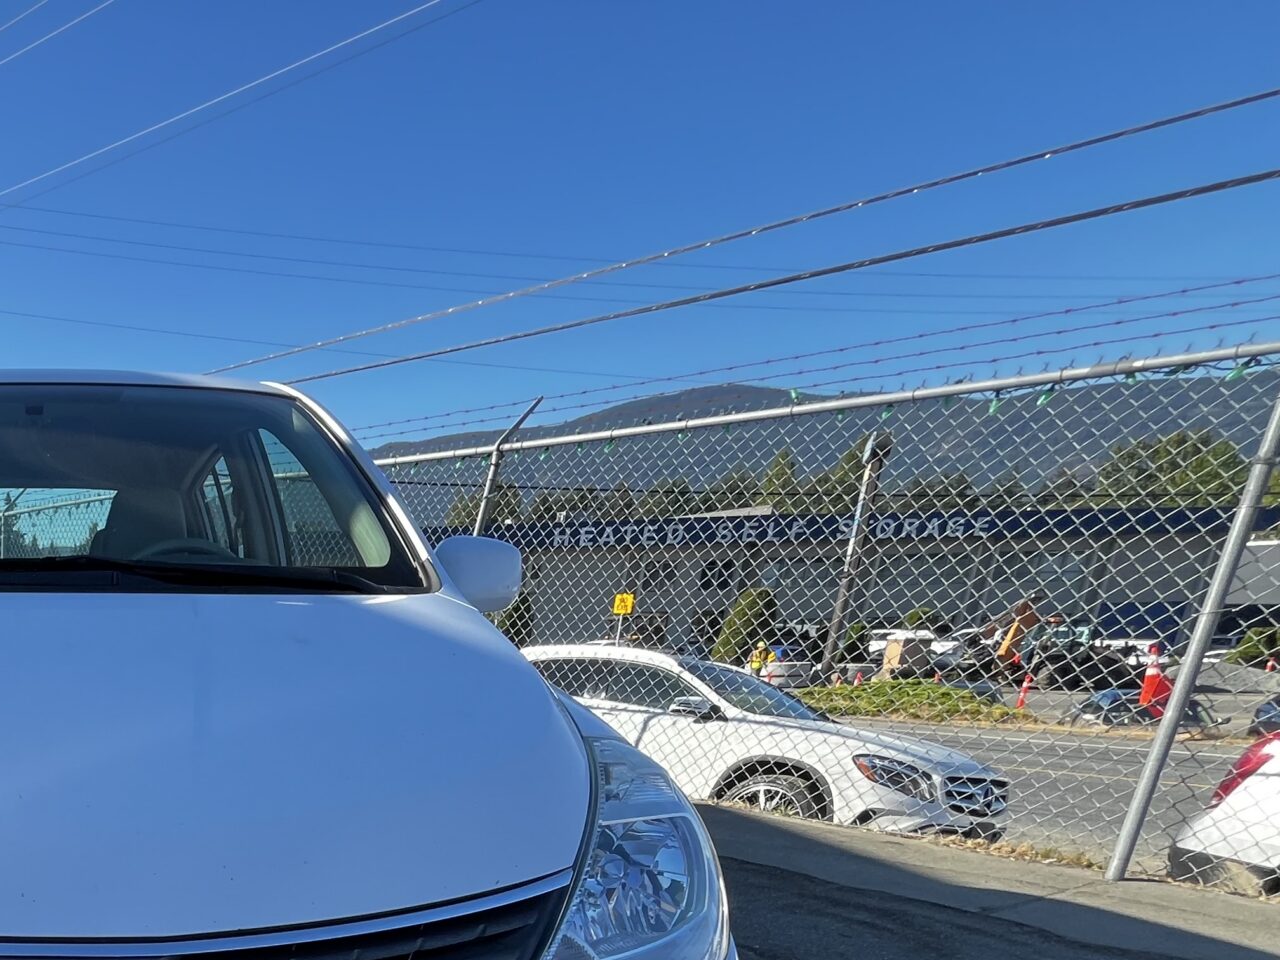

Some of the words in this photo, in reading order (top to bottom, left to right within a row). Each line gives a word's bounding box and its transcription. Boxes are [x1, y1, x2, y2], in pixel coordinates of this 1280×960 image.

[553, 525, 684, 547] HEATED
[716, 521, 807, 543] SELF
[835, 516, 992, 540] SORAGE
